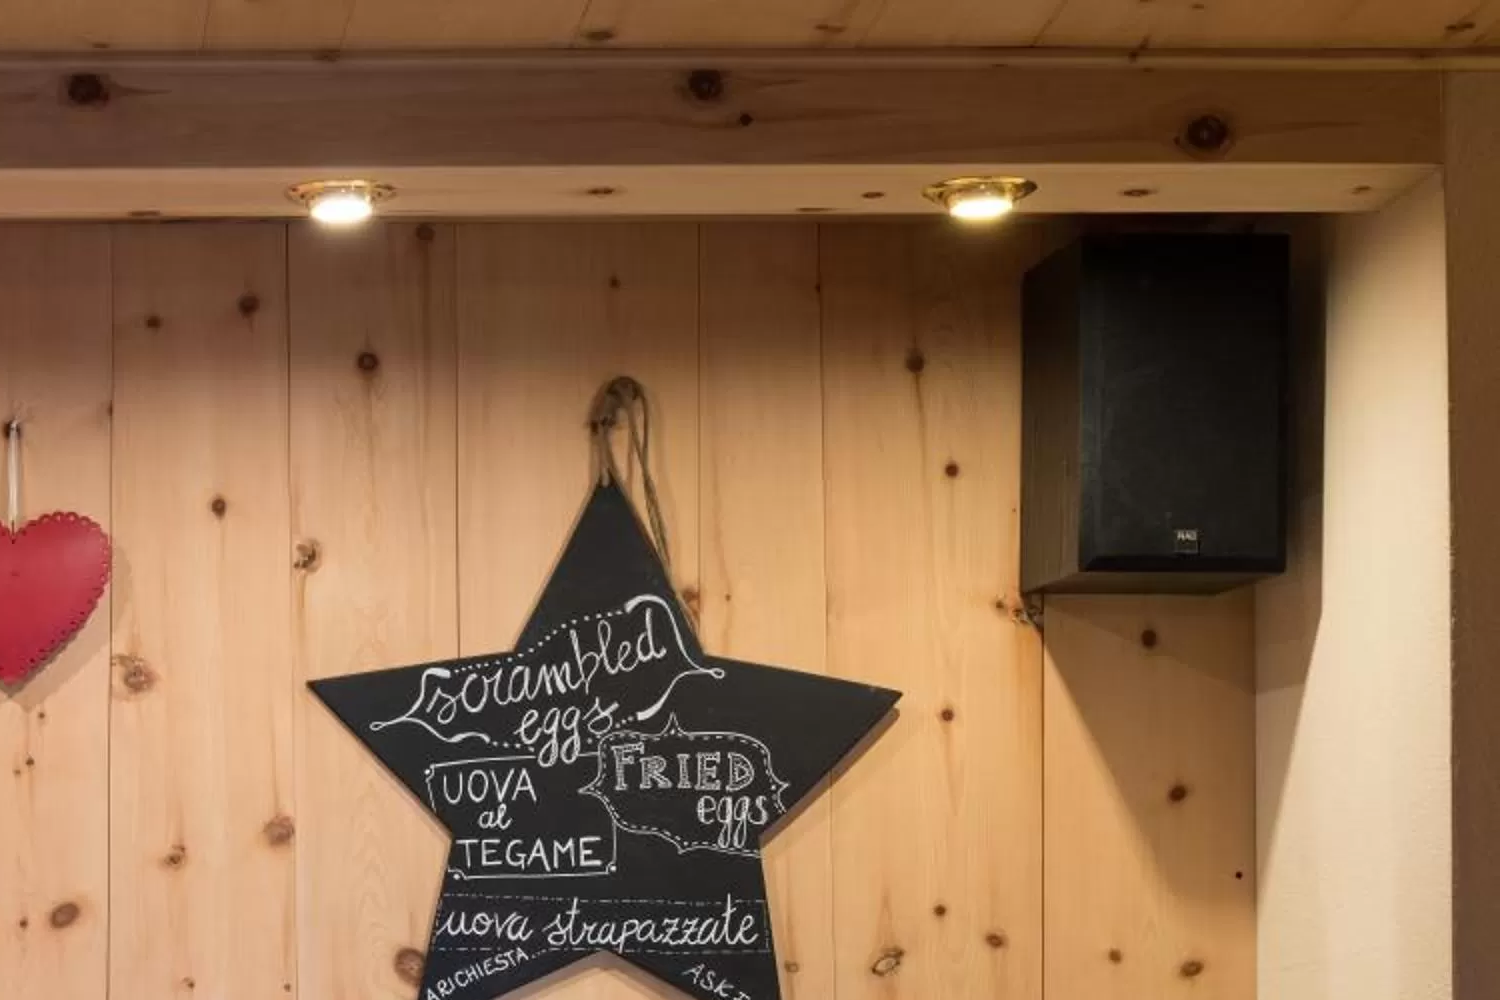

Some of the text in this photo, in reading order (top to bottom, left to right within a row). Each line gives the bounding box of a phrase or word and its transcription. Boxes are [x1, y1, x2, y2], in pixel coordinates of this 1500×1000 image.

[514, 697, 620, 768] eggs
[443, 768, 537, 804] UOVA
[611, 742, 755, 791] FRIED
[478, 803, 513, 830] al
[697, 795, 769, 849] eggs
[456, 836, 603, 872] TEGAME
[436, 892, 759, 954] uova strapazzate
[682, 963, 735, 998] ASK
